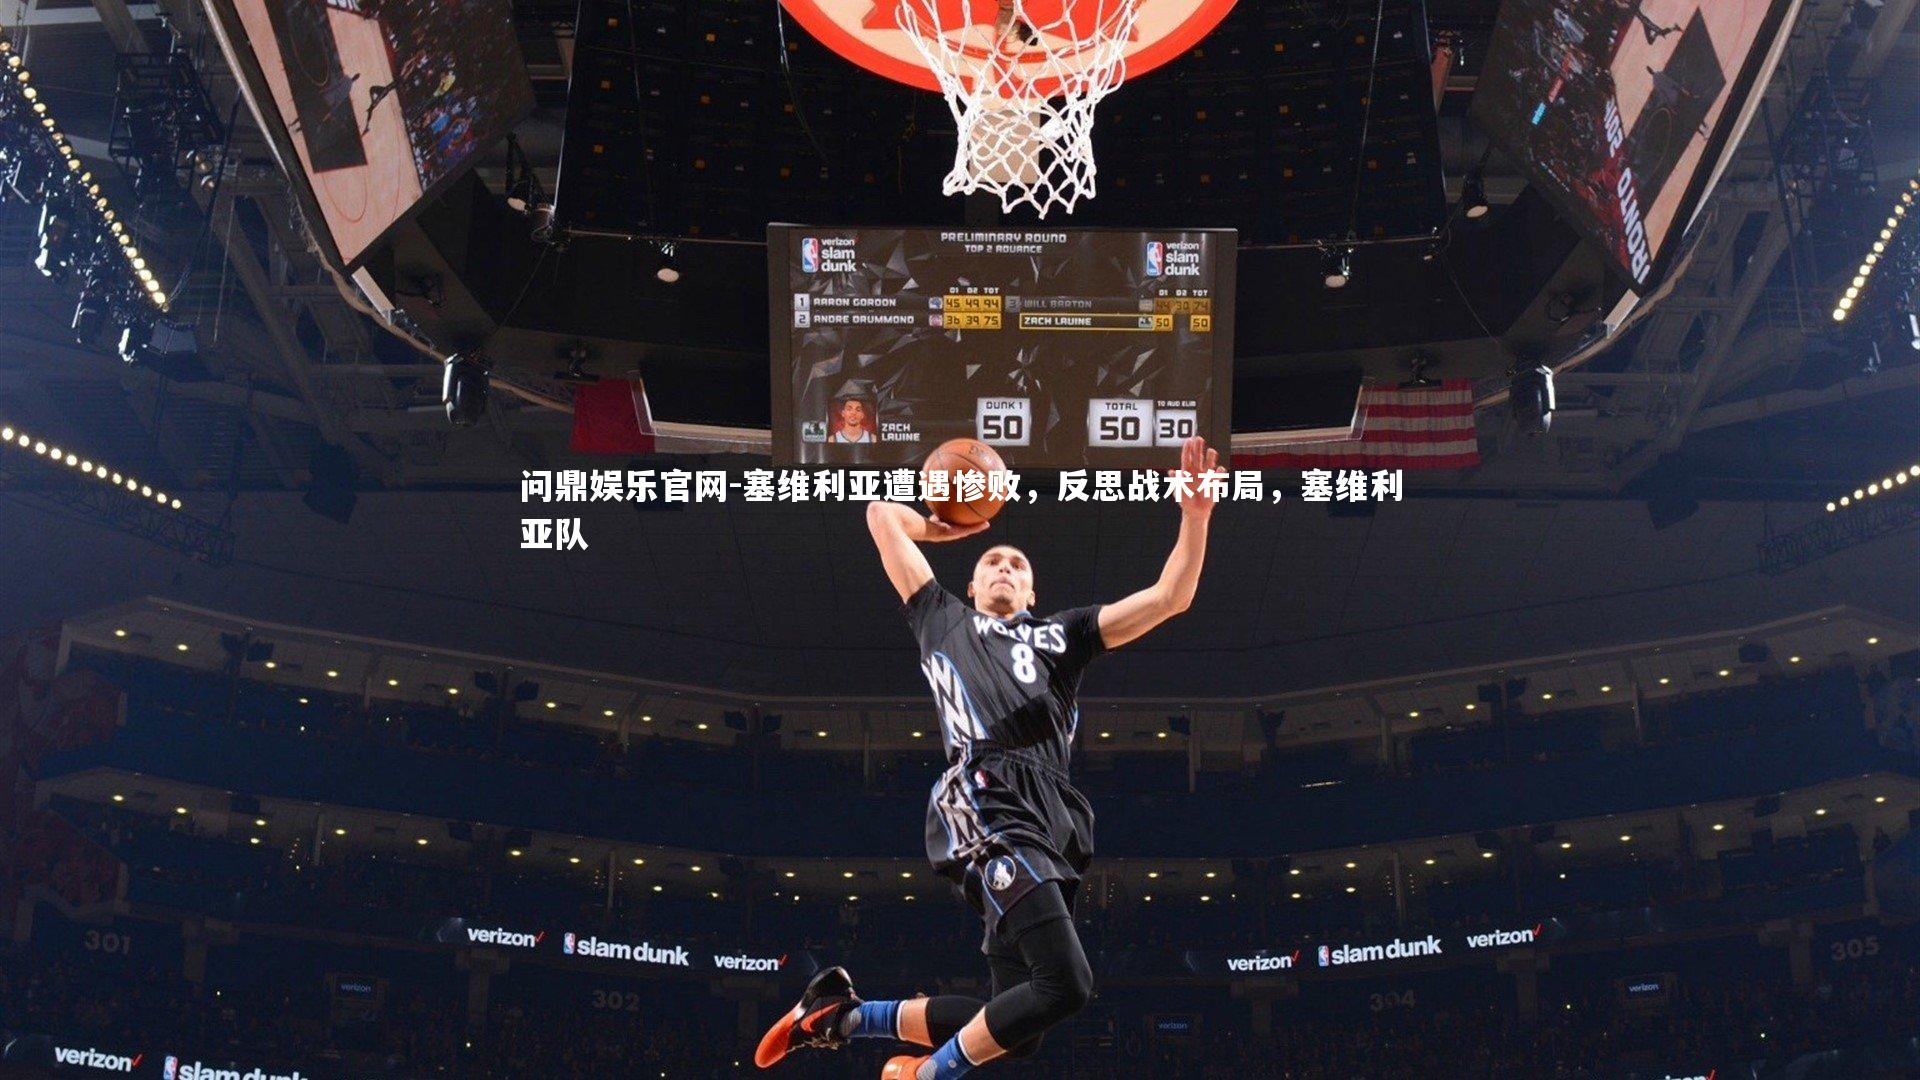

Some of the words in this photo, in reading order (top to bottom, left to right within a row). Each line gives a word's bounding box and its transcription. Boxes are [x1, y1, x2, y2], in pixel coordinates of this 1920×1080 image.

[821, 237, 855, 246] verizon
[941, 232, 1022, 242] PRELIMINARY
[1025, 233, 1067, 243] ROUND
[1165, 241, 1200, 250] verizon
[821, 246, 856, 259] slam
[965, 244, 984, 253] TOP
[986, 245, 993, 253] 2
[1165, 250, 1200, 263] slam
[821, 259, 857, 272] dunk
[1164, 263, 1200, 276] dunk
[813, 298, 850, 307] AARON
[852, 298, 897, 307] GORDON
[946, 299, 960, 308] 45
[813, 315, 850, 324] ANDRE
[852, 315, 915, 324] DRUMMOND
[983, 315, 999, 325] 75
[1024, 317, 1052, 325] ZACH
[1156, 318, 1170, 327] 50
[1193, 318, 1208, 328] 50
[986, 401, 1015, 409] DUNK
[1105, 402, 1138, 410] TOTAL
[881, 423, 911, 432] ZACH
[983, 415, 1023, 440] 50
[1100, 416, 1140, 441] 50
[1159, 418, 1193, 438] 30
[973, 615, 1067, 653] WOLVES
[1011, 643, 1036, 683] 8
[84, 929, 131, 955] 301
[467, 926, 537, 948] verizon
[1466, 929, 1535, 949] verizon
[576, 935, 632, 960] slam
[632, 941, 690, 967] dunk
[1331, 943, 1385, 965] slam
[1385, 934, 1443, 959] dunk
[1830, 935, 1880, 962] 305
[713, 953, 780, 972] verizon
[1226, 950, 1293, 972] verizon
[592, 988, 640, 1012] 302
[55, 1046, 132, 1073] verizon
